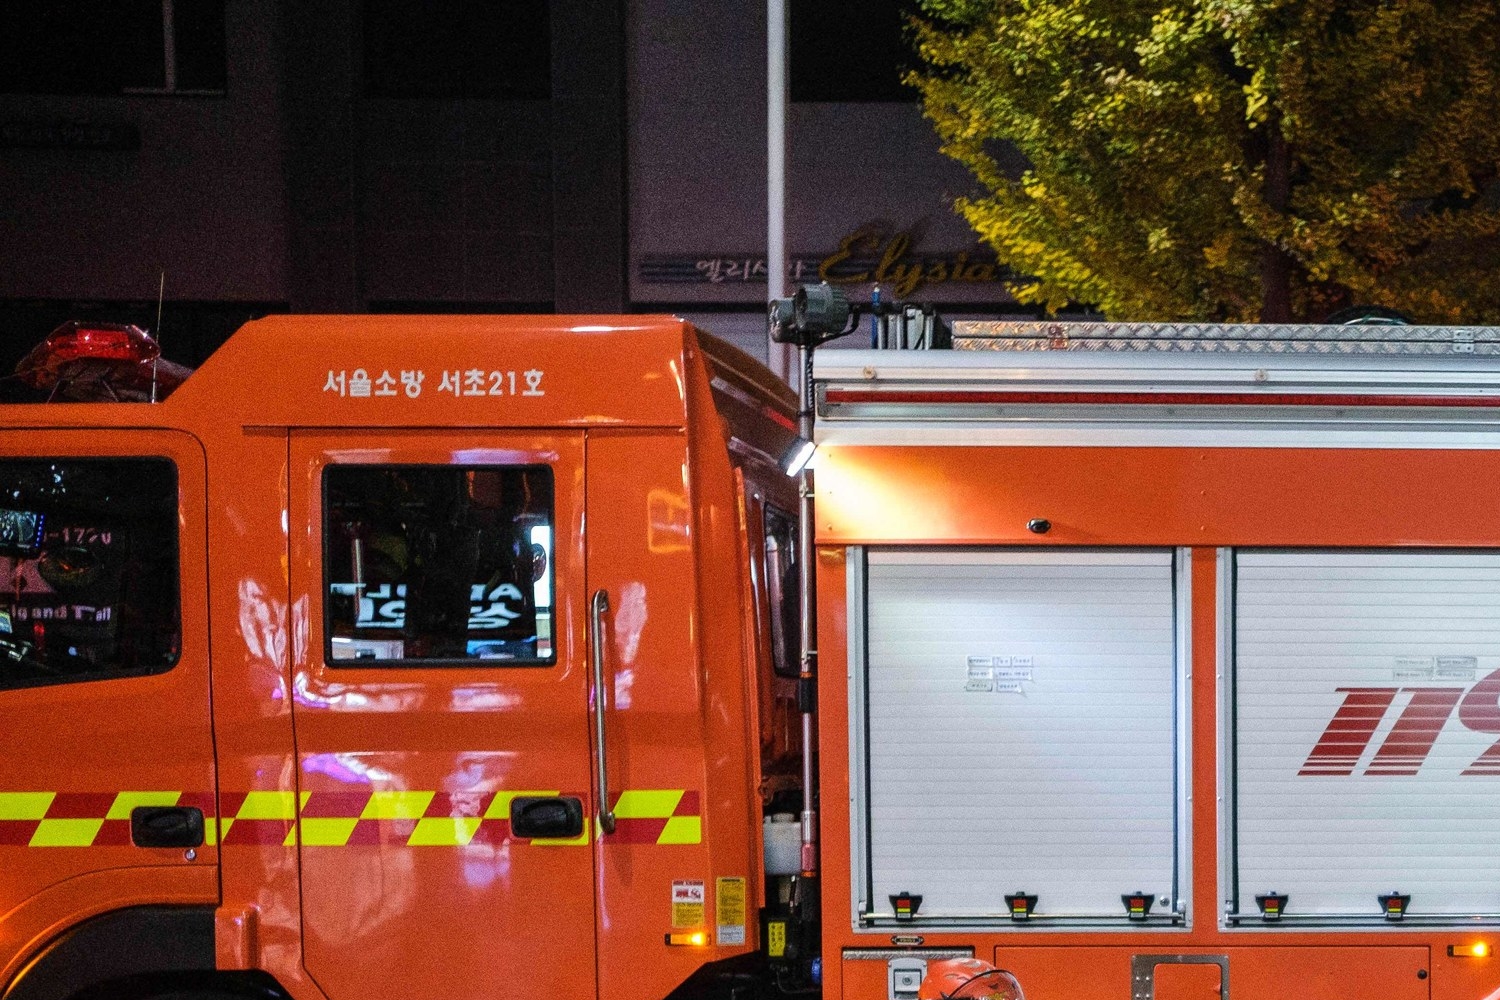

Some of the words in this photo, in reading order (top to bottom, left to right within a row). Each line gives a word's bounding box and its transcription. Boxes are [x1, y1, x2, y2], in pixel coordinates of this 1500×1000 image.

[818, 226, 999, 298] Elysia
[323, 369, 425, 398] 서울소방
[438, 369, 545, 397] 서초21호
